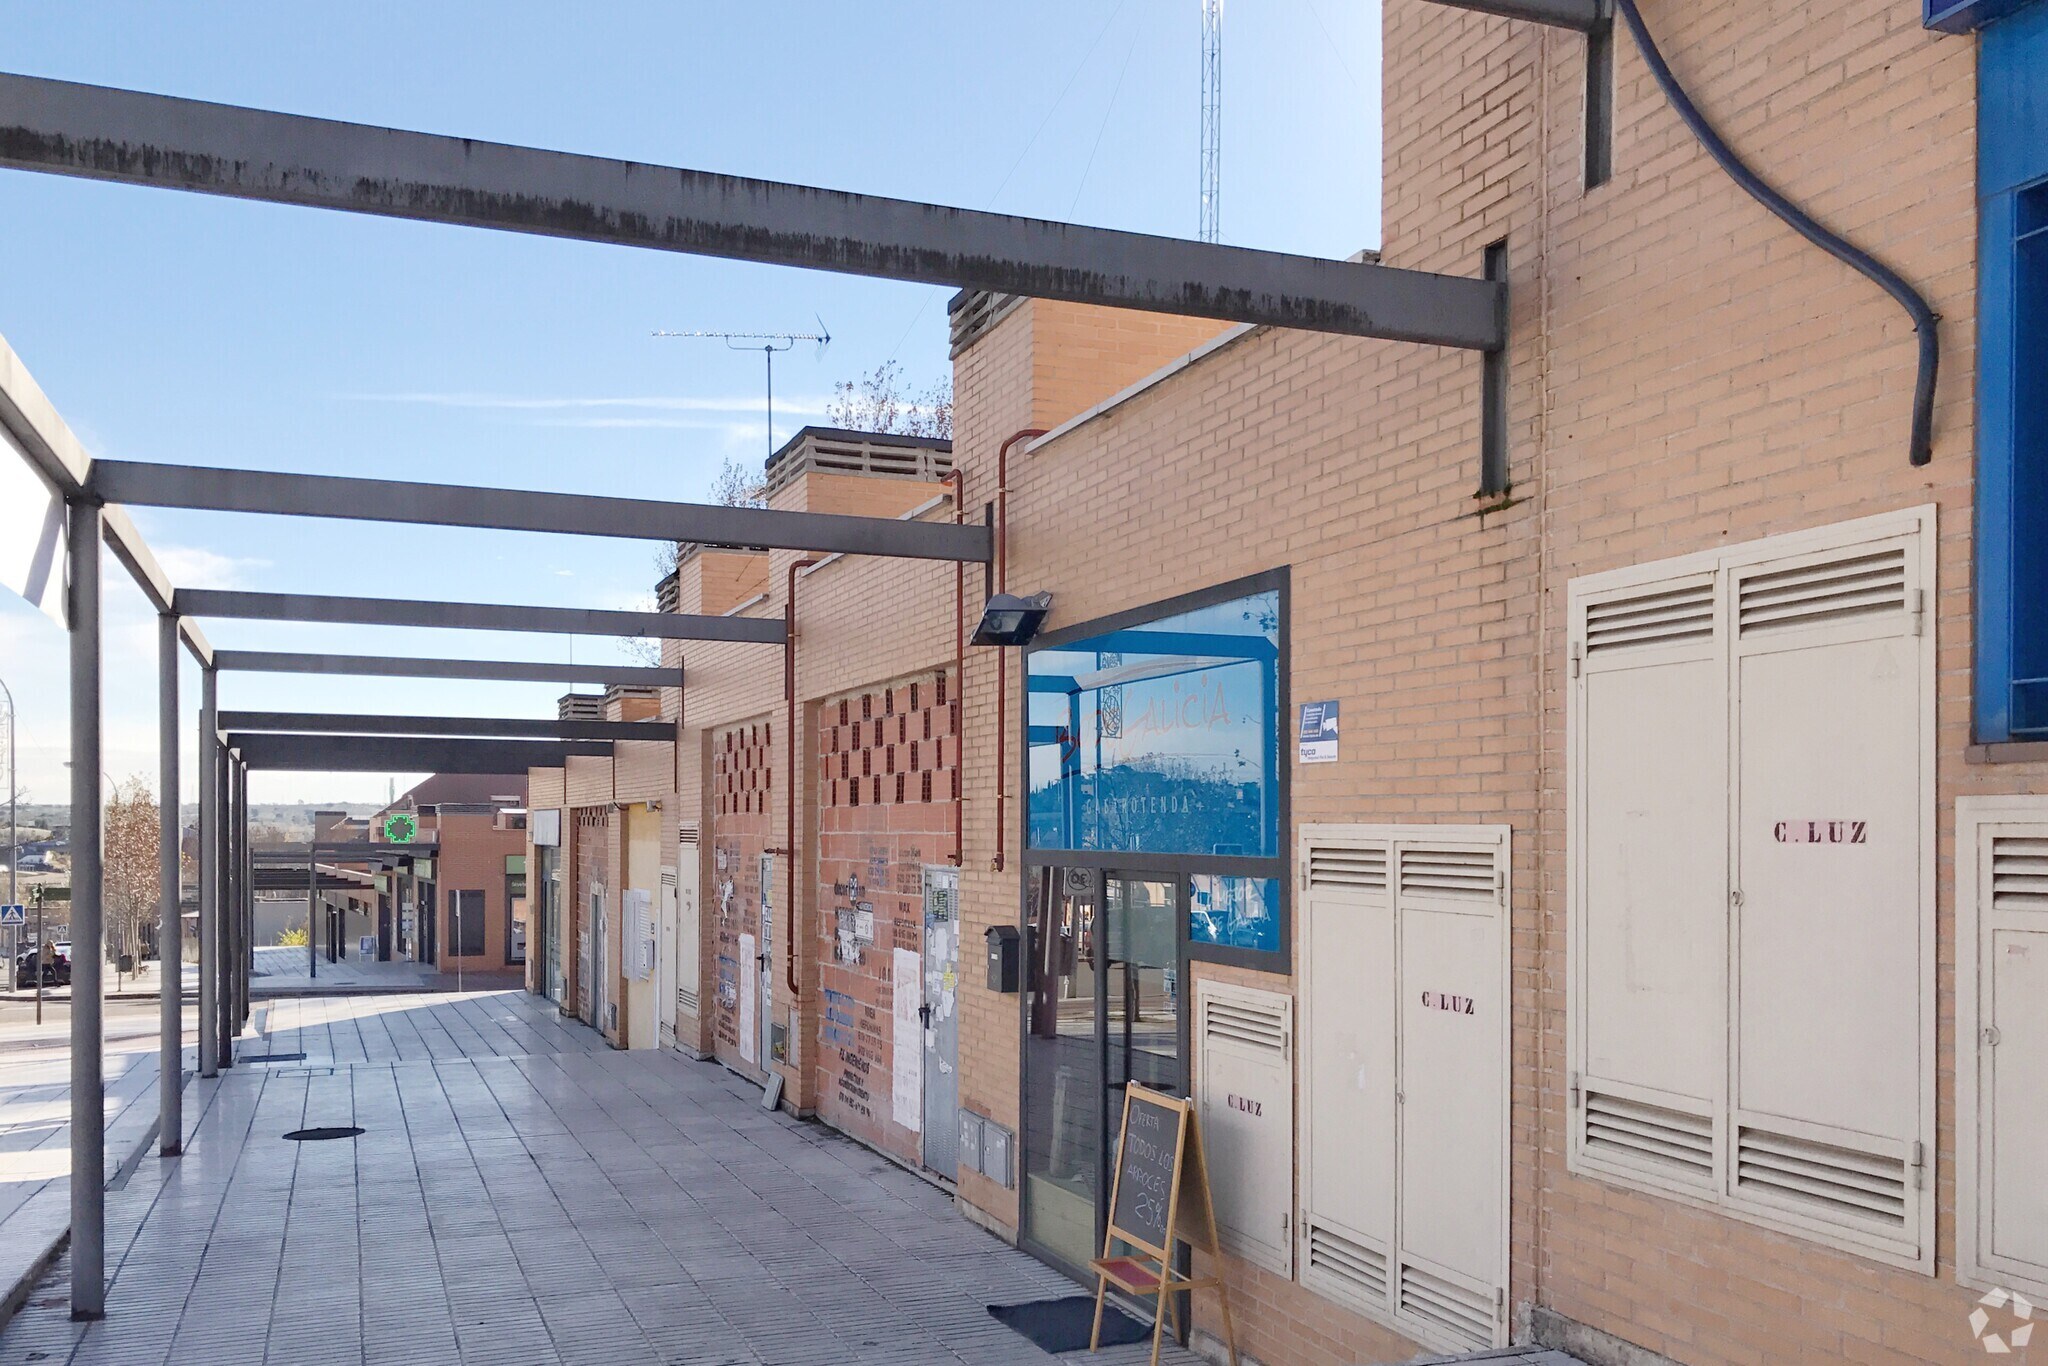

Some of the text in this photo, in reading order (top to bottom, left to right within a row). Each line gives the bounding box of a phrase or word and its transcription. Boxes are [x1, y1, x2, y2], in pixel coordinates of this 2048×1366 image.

[1300, 748, 1316, 757] tyco
[1130, 1104, 1159, 1131] OFERTA
[1128, 1133, 1157, 1161] TODOS
